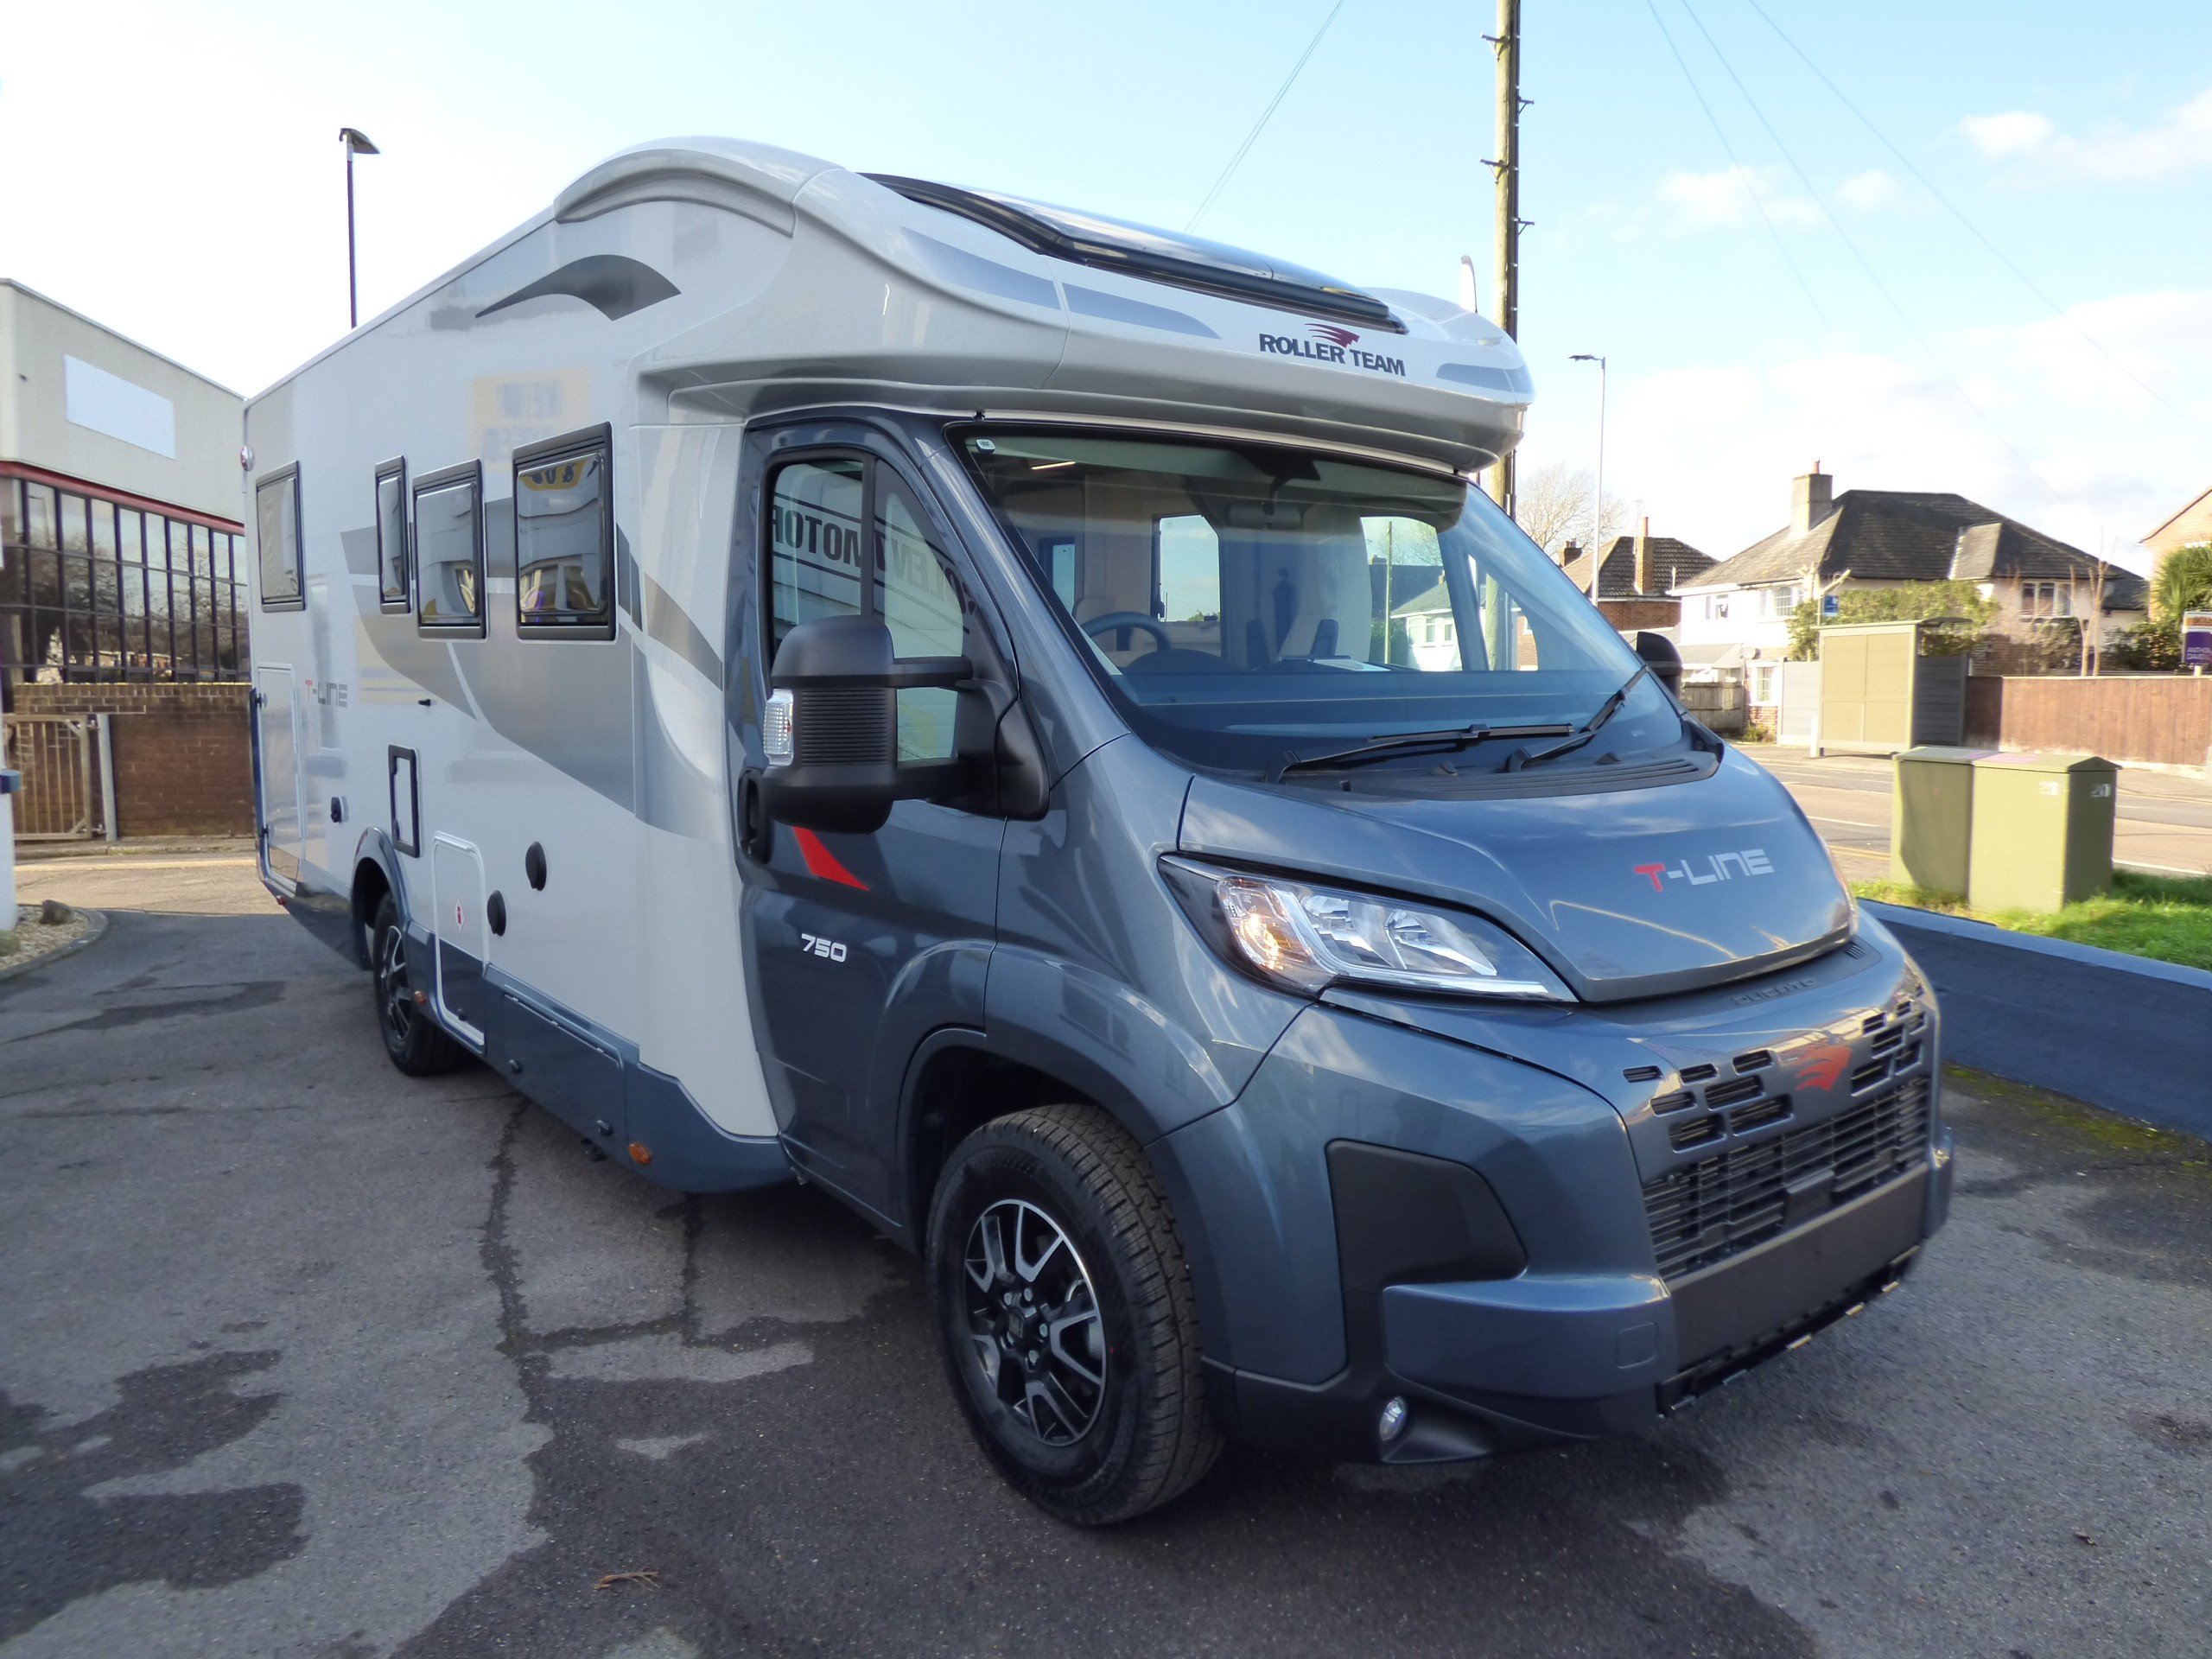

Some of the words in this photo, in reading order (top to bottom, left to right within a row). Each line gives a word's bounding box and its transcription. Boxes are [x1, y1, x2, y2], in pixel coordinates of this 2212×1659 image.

[1259, 333, 1345, 364] ROLLER
[1349, 348, 1407, 377] TEAM
[1632, 849, 1775, 893] T-LINE
[801, 933, 848, 963] 750
